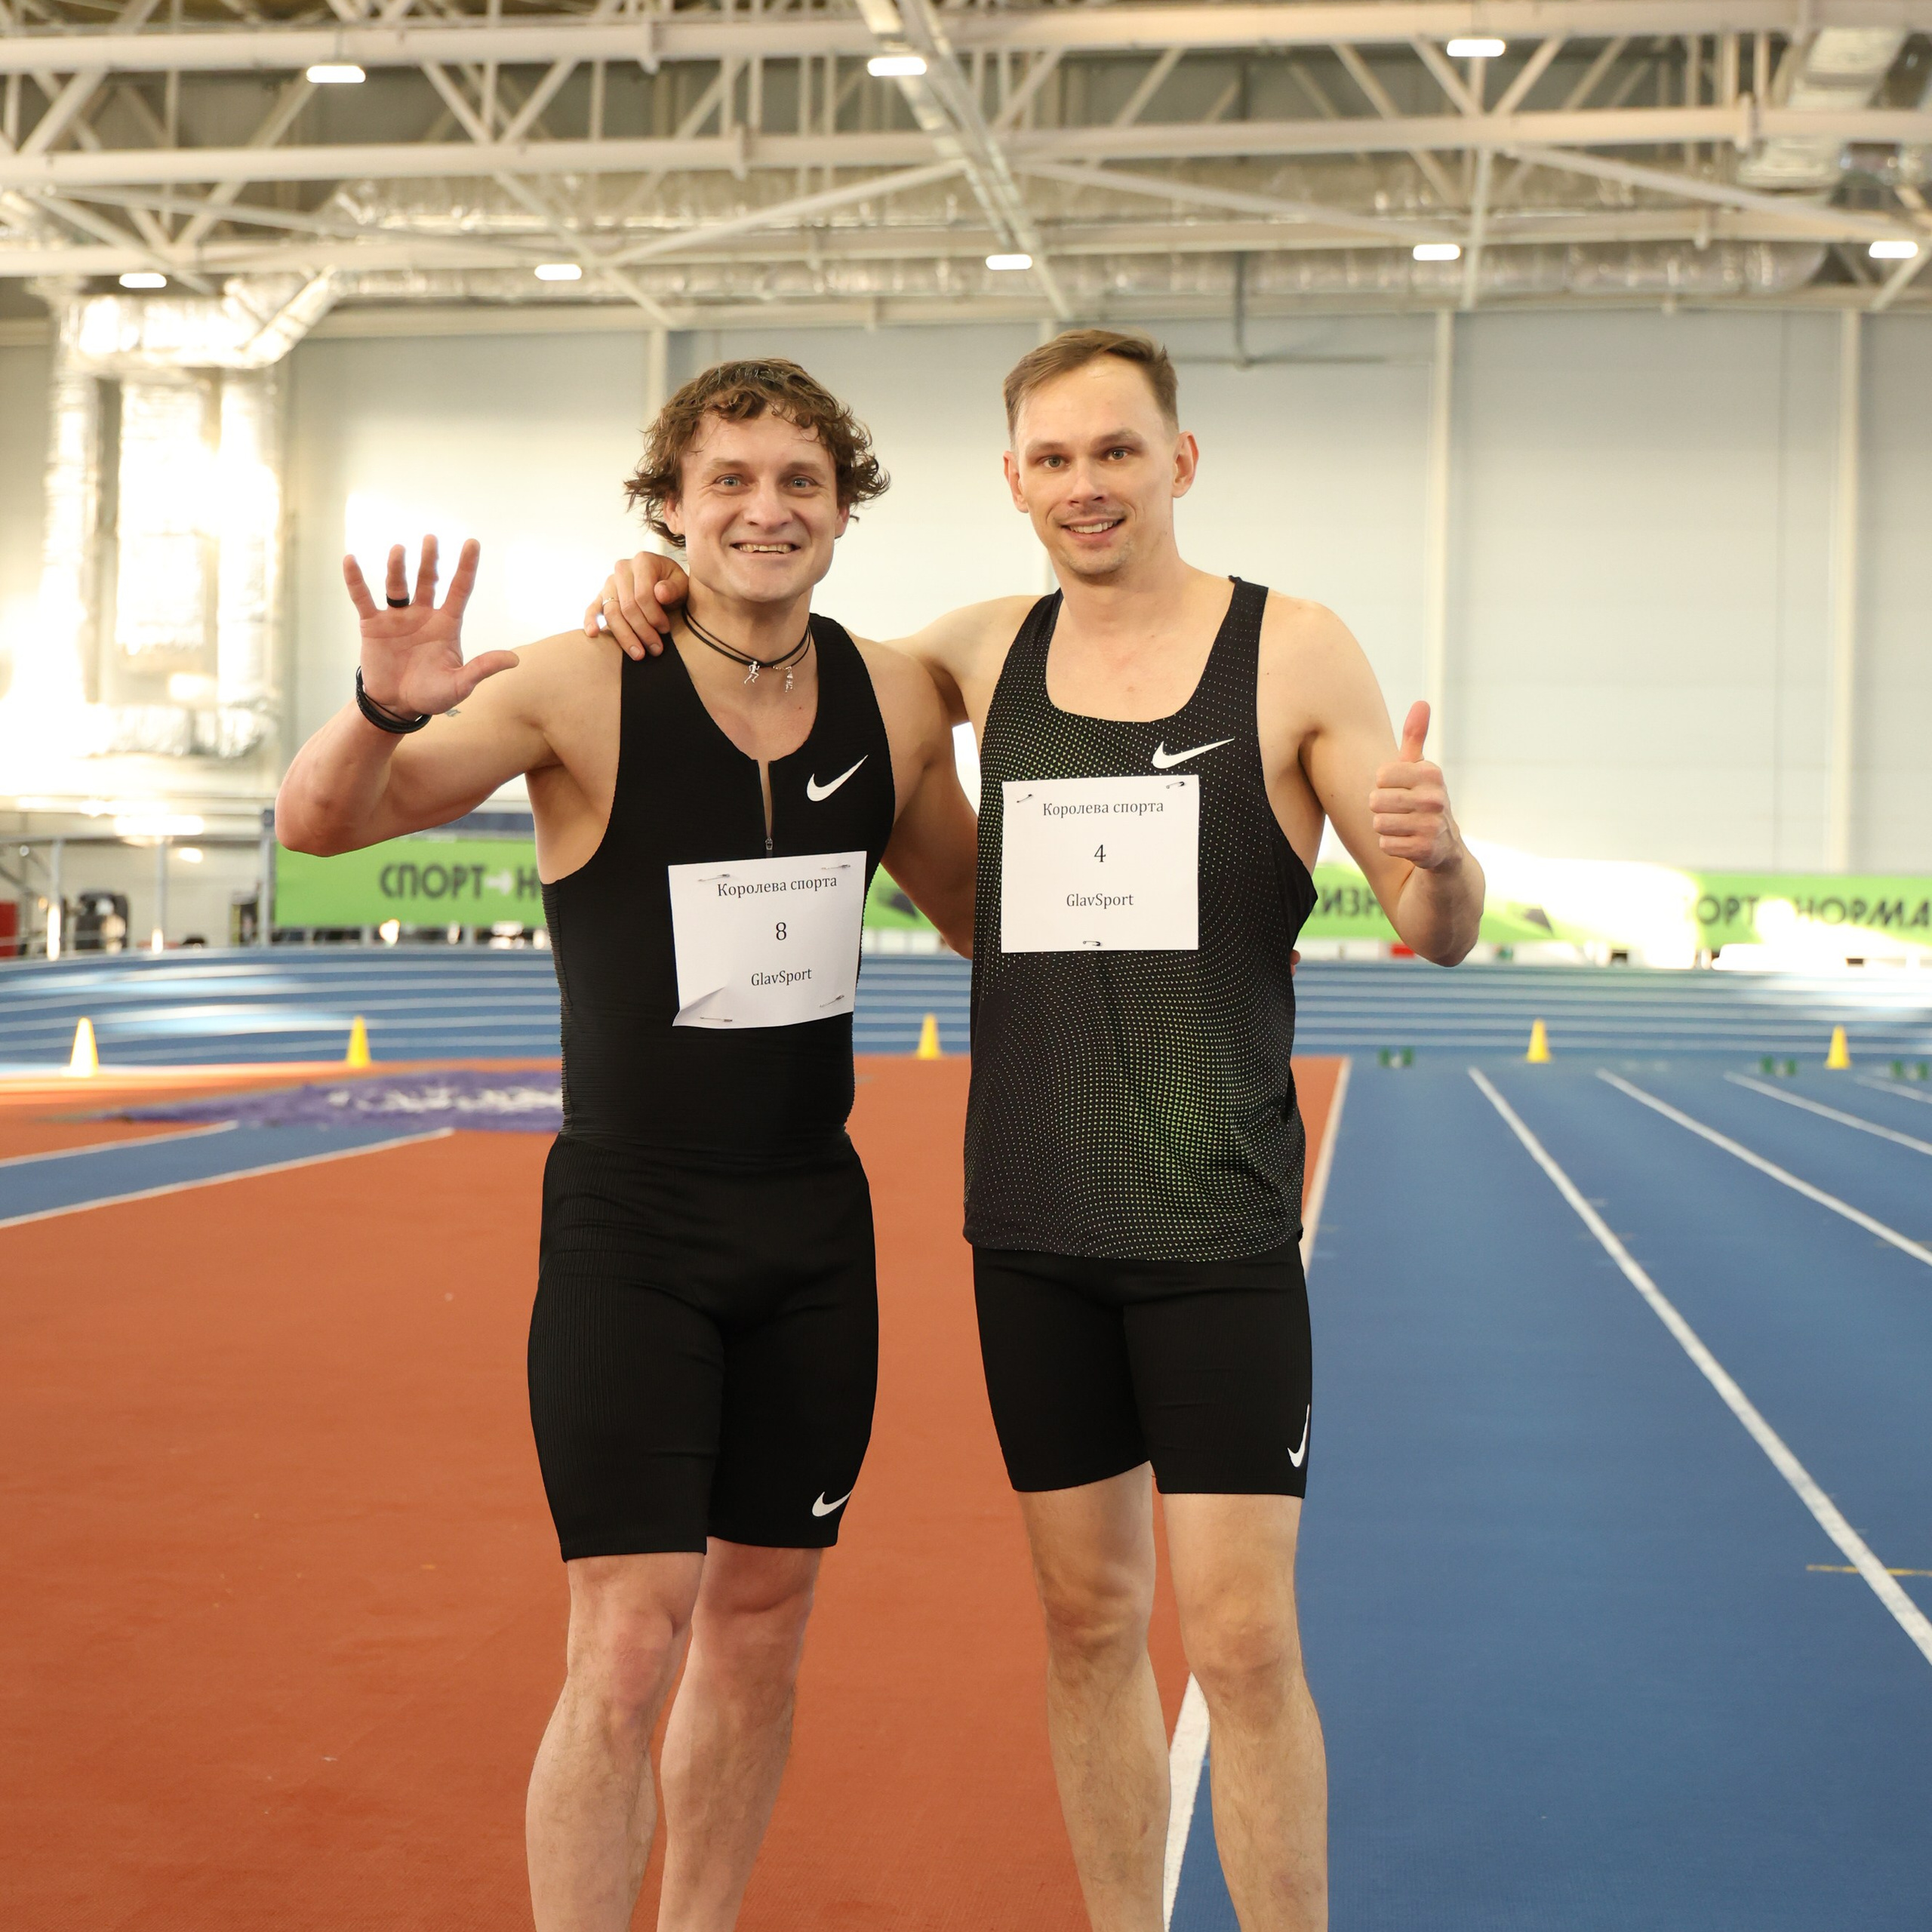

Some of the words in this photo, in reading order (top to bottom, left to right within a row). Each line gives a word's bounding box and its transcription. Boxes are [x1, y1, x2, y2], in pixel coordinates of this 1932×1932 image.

[1043, 802, 1109, 819] Королева
[1113, 801, 1164, 817] спорта
[1094, 844, 1106, 863] 4
[380, 864, 485, 898] СПОРТ
[717, 880, 786, 898] Королева
[790, 876, 838, 893] спорта
[1066, 893, 1134, 909] GlavSport
[775, 921, 787, 941] 8
[751, 968, 812, 986] GlavSport
